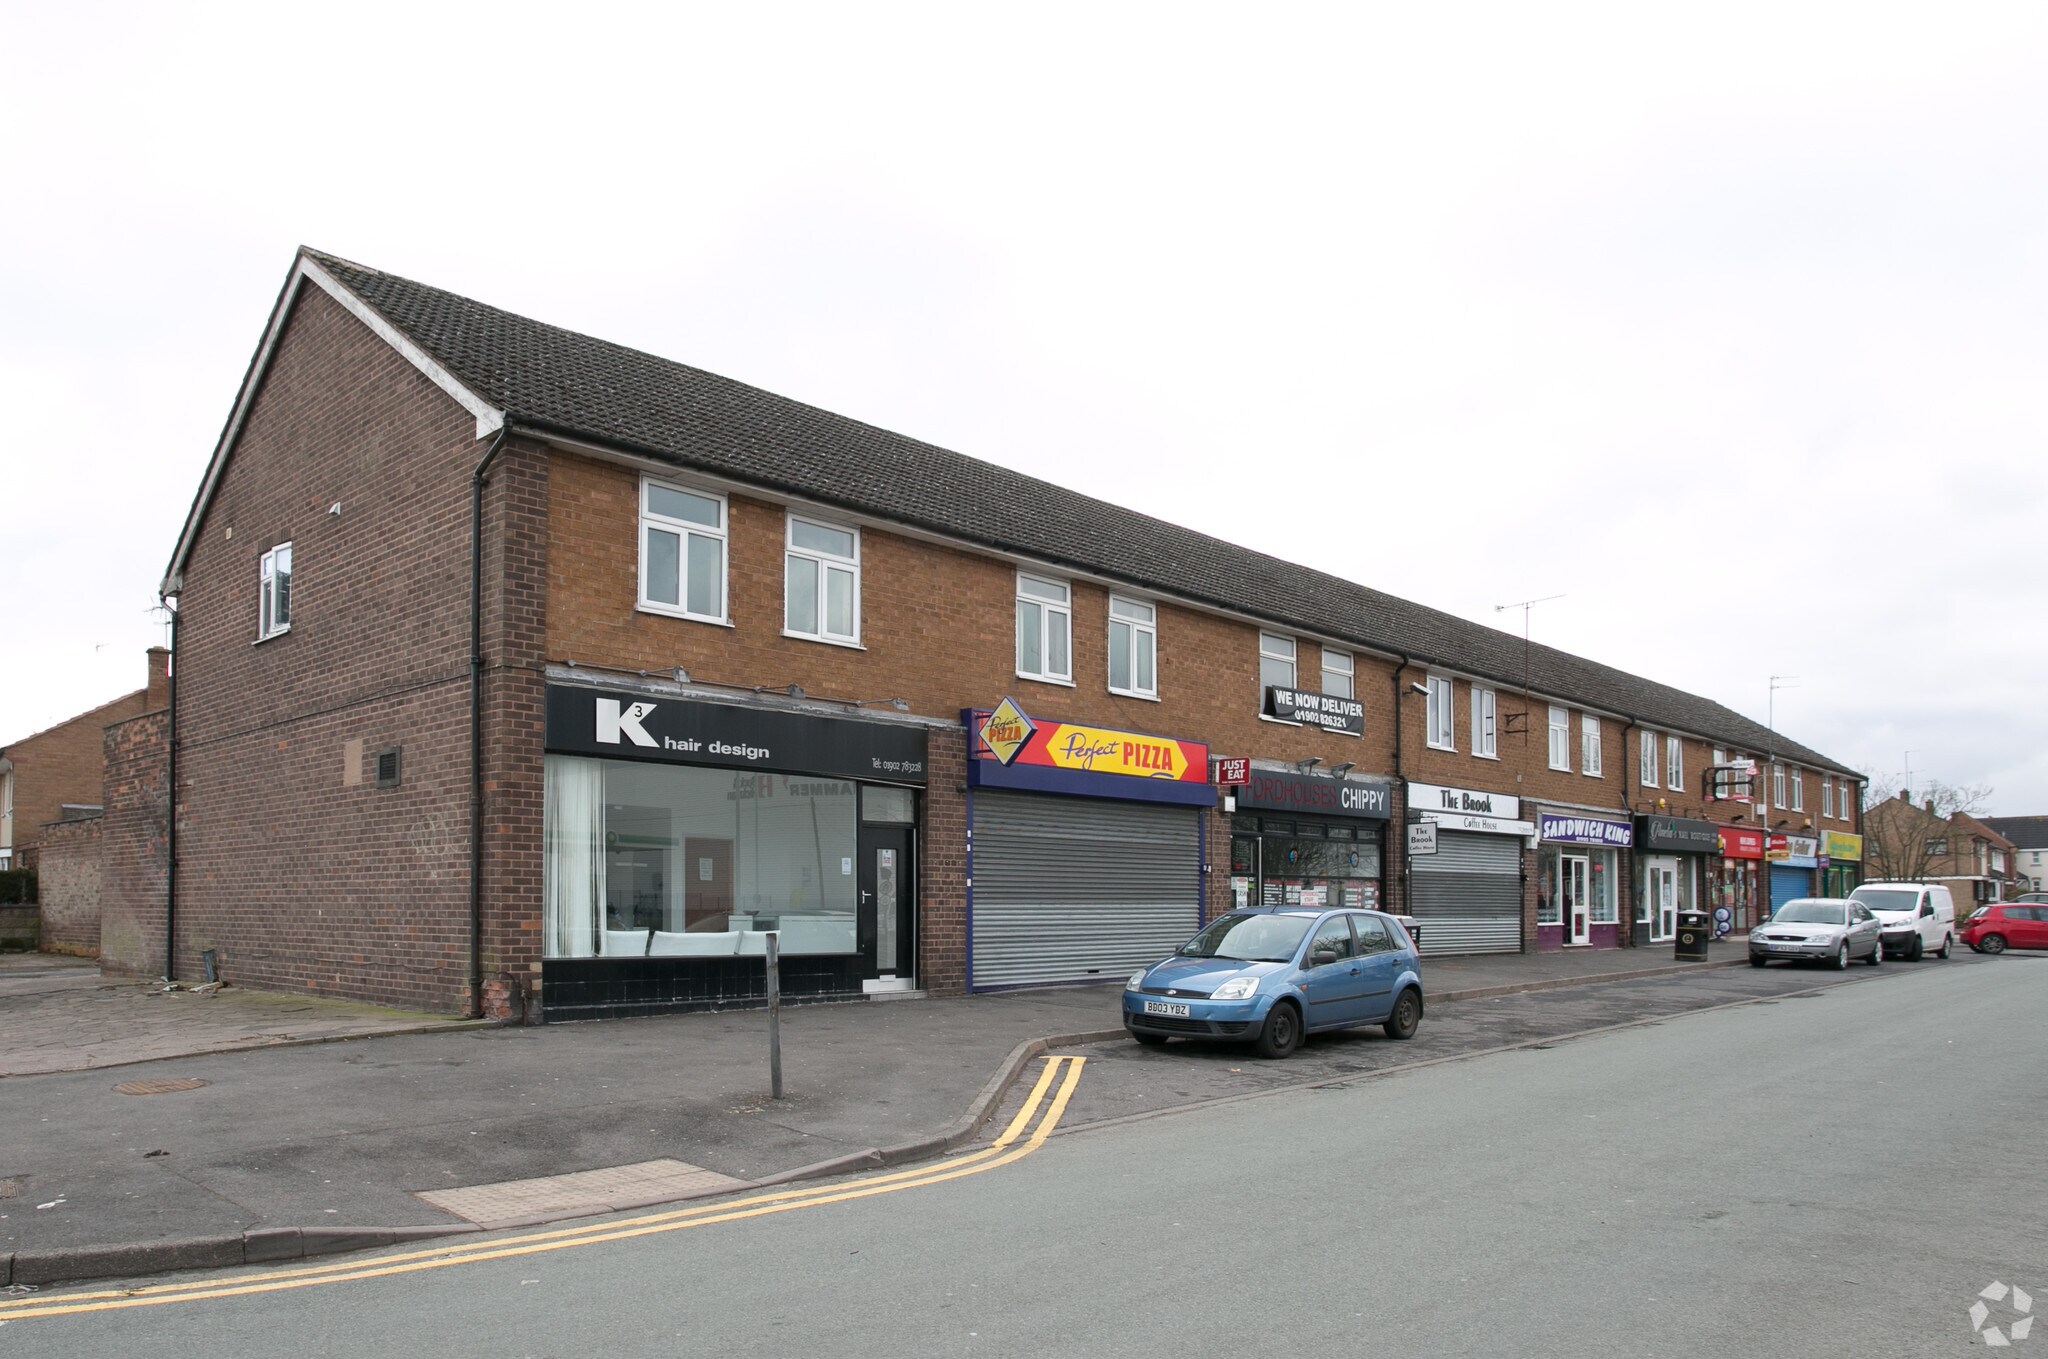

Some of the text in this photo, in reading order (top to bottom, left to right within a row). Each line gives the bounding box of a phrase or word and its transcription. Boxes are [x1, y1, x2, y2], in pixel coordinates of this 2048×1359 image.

[1275, 689, 1364, 717] WE NOW DELIVER
[986, 715, 1020, 735] Perfect
[1294, 709, 1347, 728] 01902 826321
[988, 725, 1022, 743] PIZZA
[664, 736, 770, 760] hair design
[1060, 732, 1173, 771] Perfect PIZZA
[883, 760, 900, 772] 01902
[901, 760, 922, 773] 783228
[1222, 760, 1246, 770] JUST
[1227, 769, 1246, 780] EAT
[1245, 778, 1384, 811] FORDHOUSES CHIPPY
[1462, 792, 1492, 813] Brook
[1410, 836, 1433, 844] Brook
[1543, 819, 1604, 839] SANDWICH
[1604, 823, 1631, 845] KING
[1147, 1002, 1186, 1015] BD03 YBZ
